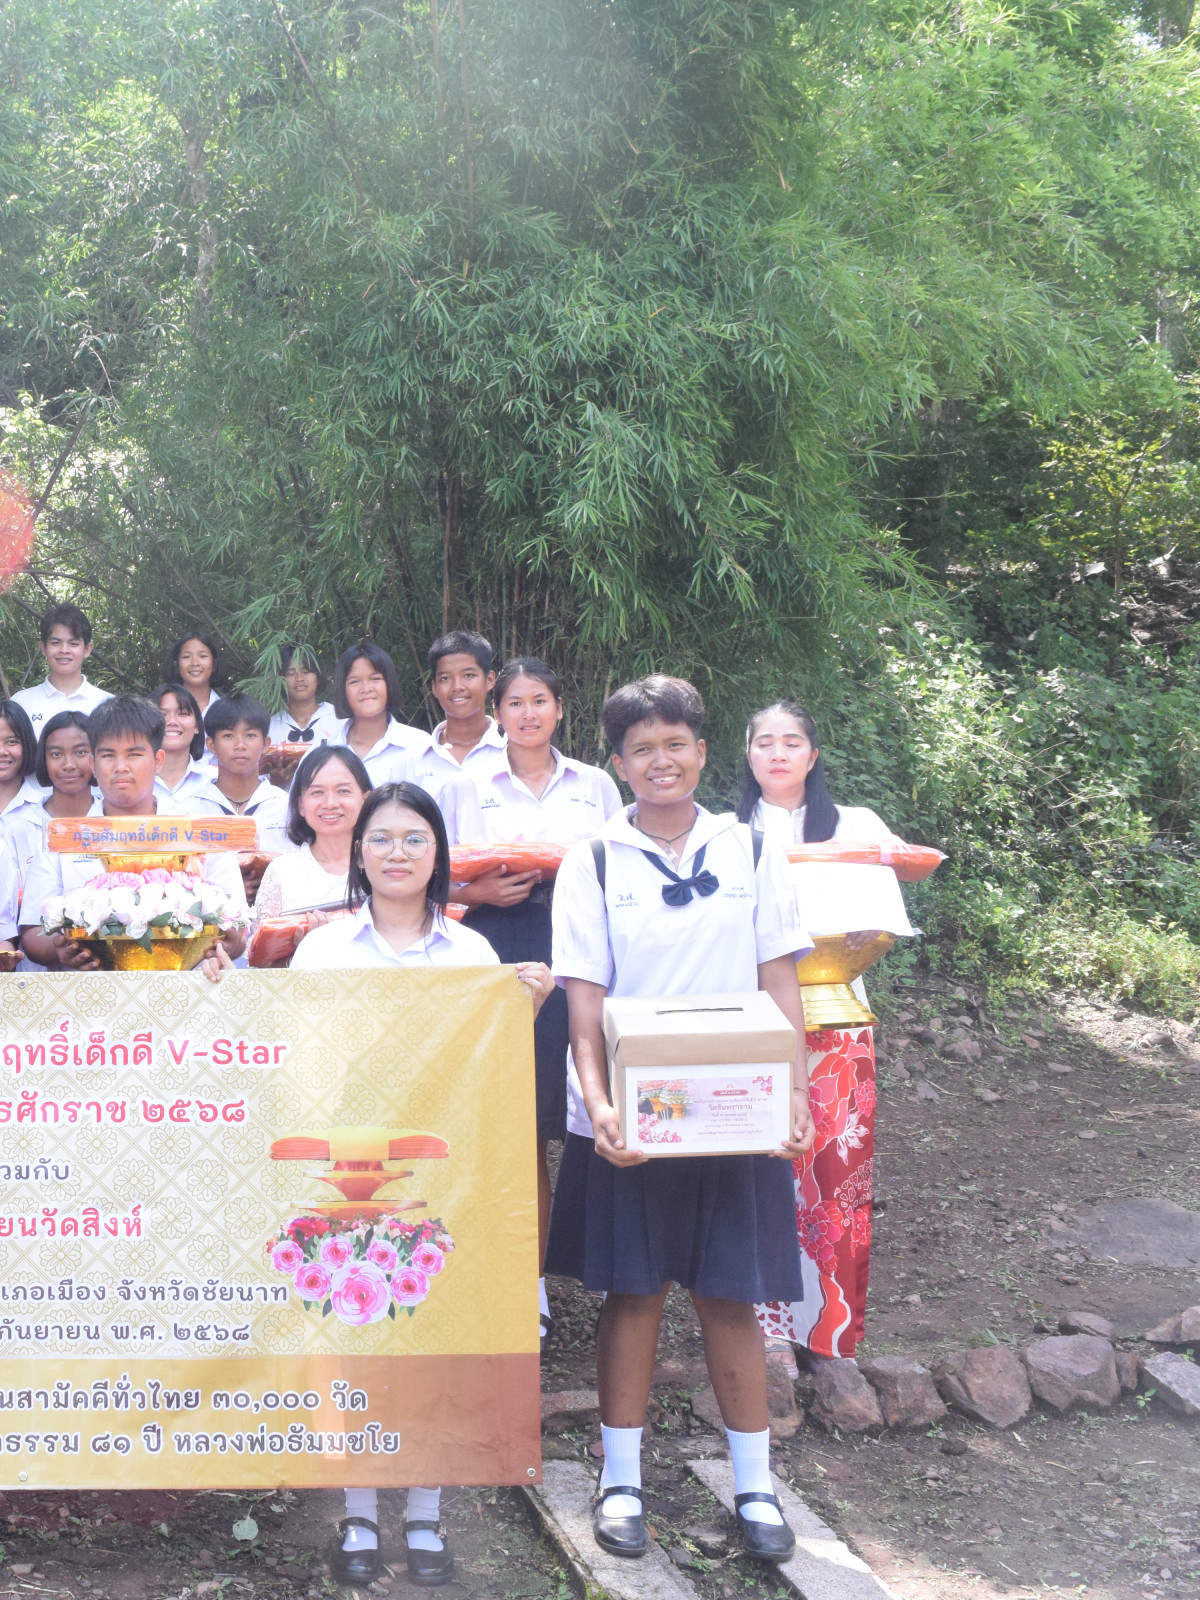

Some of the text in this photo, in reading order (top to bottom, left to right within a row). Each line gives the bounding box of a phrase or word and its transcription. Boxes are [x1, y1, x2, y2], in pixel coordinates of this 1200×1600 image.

[185, 829, 229, 842] V-Star
[168, 1039, 287, 1066] V-Star
[141, 1097, 247, 1123] ๒๕๖๘
[117, 1279, 287, 1301] จังหวัดชัยนาท
[111, 1324, 163, 1341] พ.ศ.
[174, 1323, 250, 1341] ๒๕๖๘
[212, 1389, 320, 1414] ๓๐,๐๐๐
[331, 1380, 368, 1411] วัด
[91, 1433, 132, 1454] ๘๑
[143, 1424, 162, 1452] ปี
[174, 1423, 400, 1454] หลวงพ่อธัมมชโย
